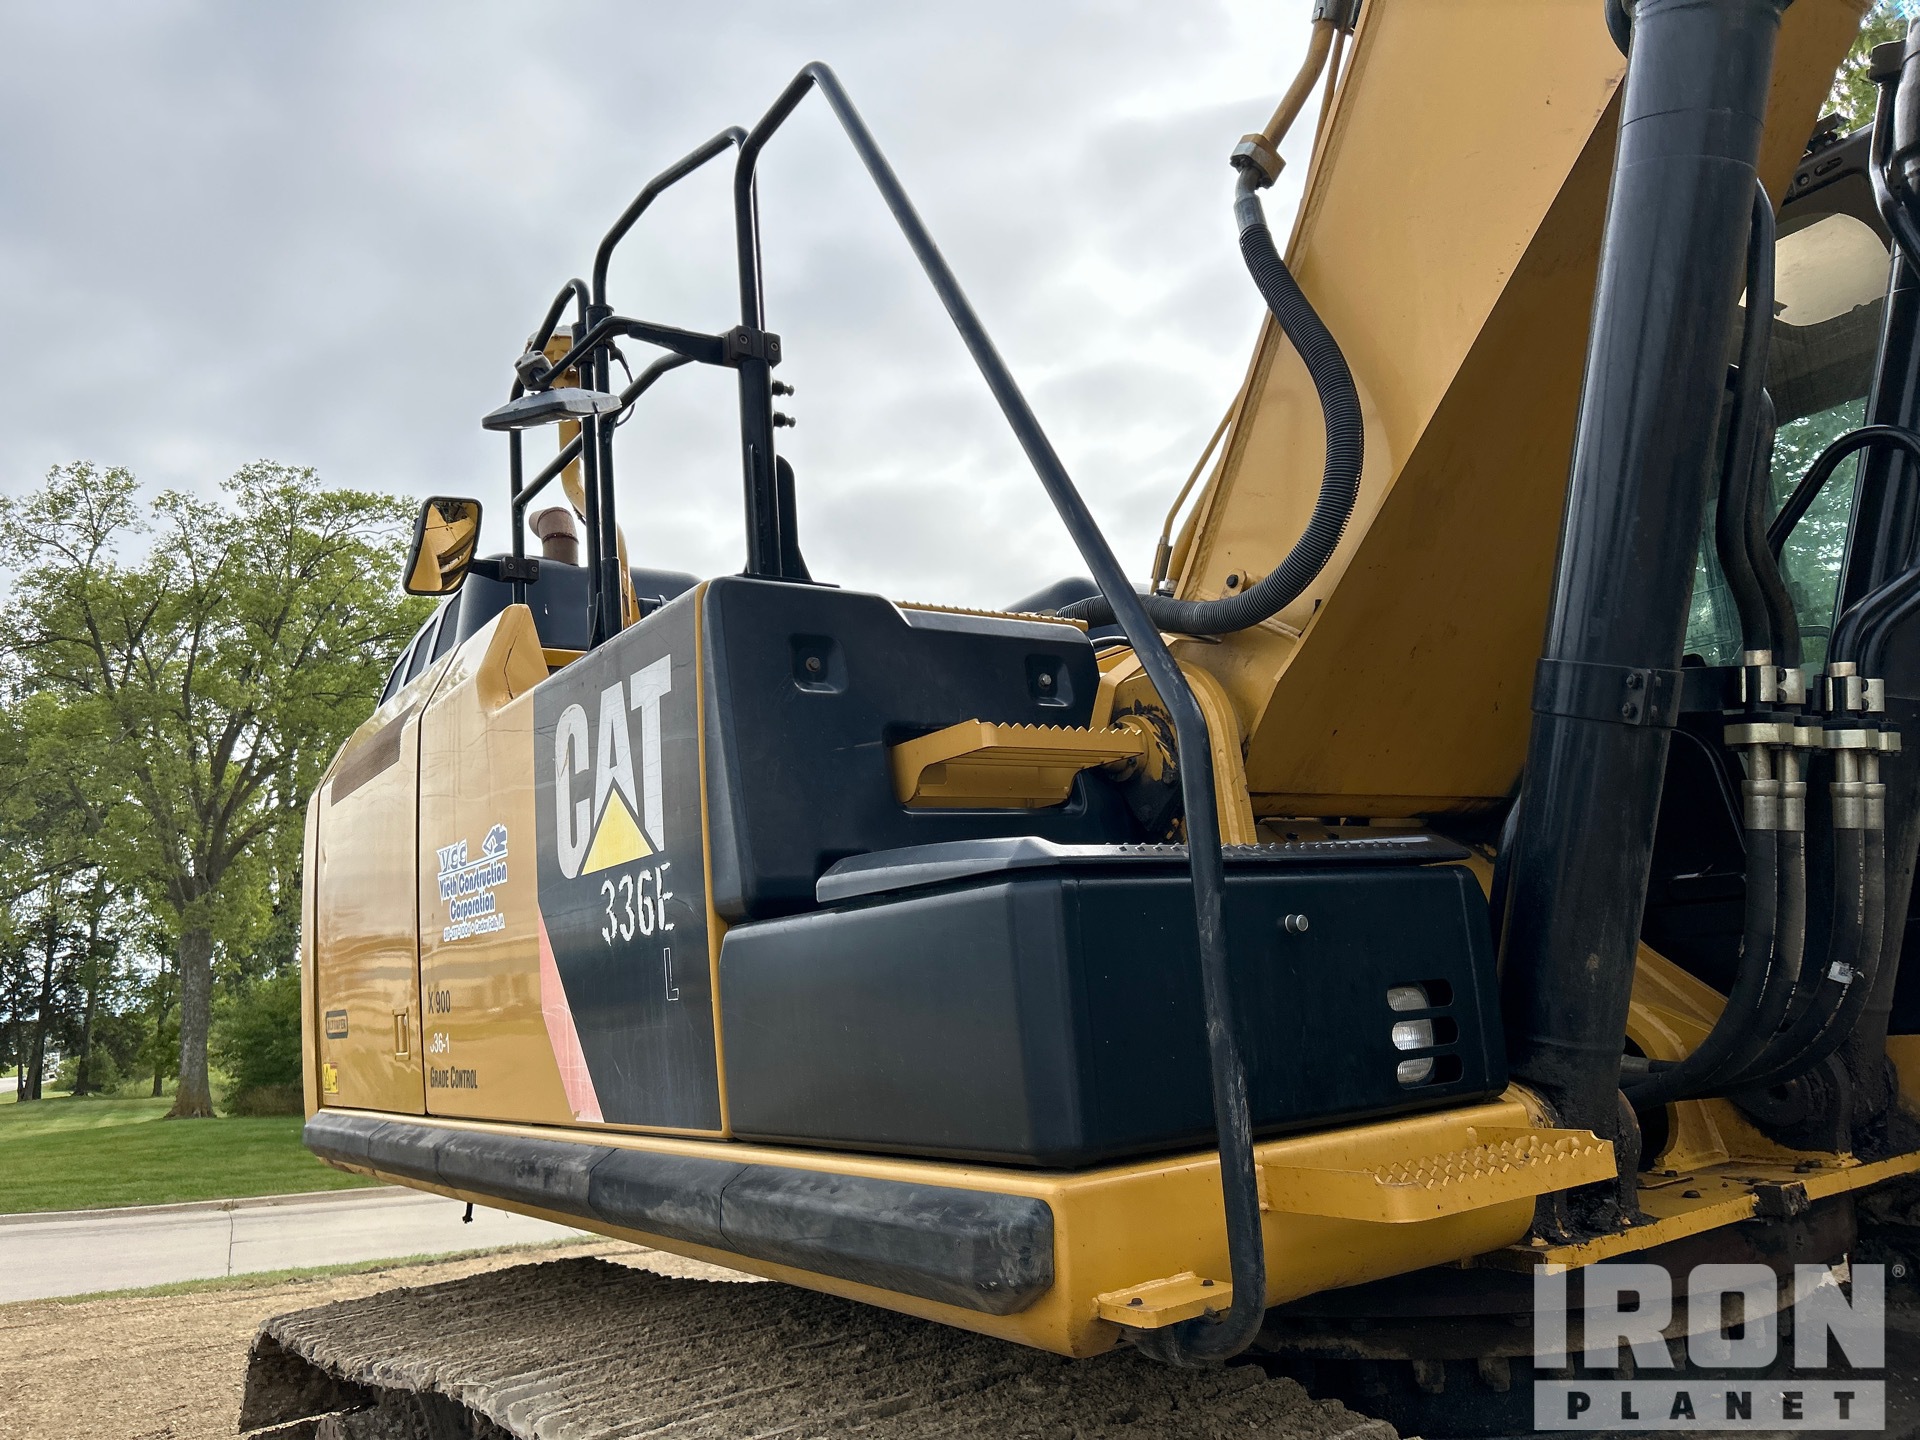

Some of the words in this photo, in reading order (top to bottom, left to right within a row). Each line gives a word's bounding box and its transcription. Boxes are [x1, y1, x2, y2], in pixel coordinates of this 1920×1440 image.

[555, 653, 672, 879] CAT
[458, 863, 507, 895] Construction
[450, 891, 495, 921] Corporation
[600, 861, 675, 946] 336E
[428, 991, 434, 1014] X
[435, 990, 451, 1013] 900
[430, 1066, 449, 1088] GRADE
[450, 1065, 478, 1089] CONTROL
